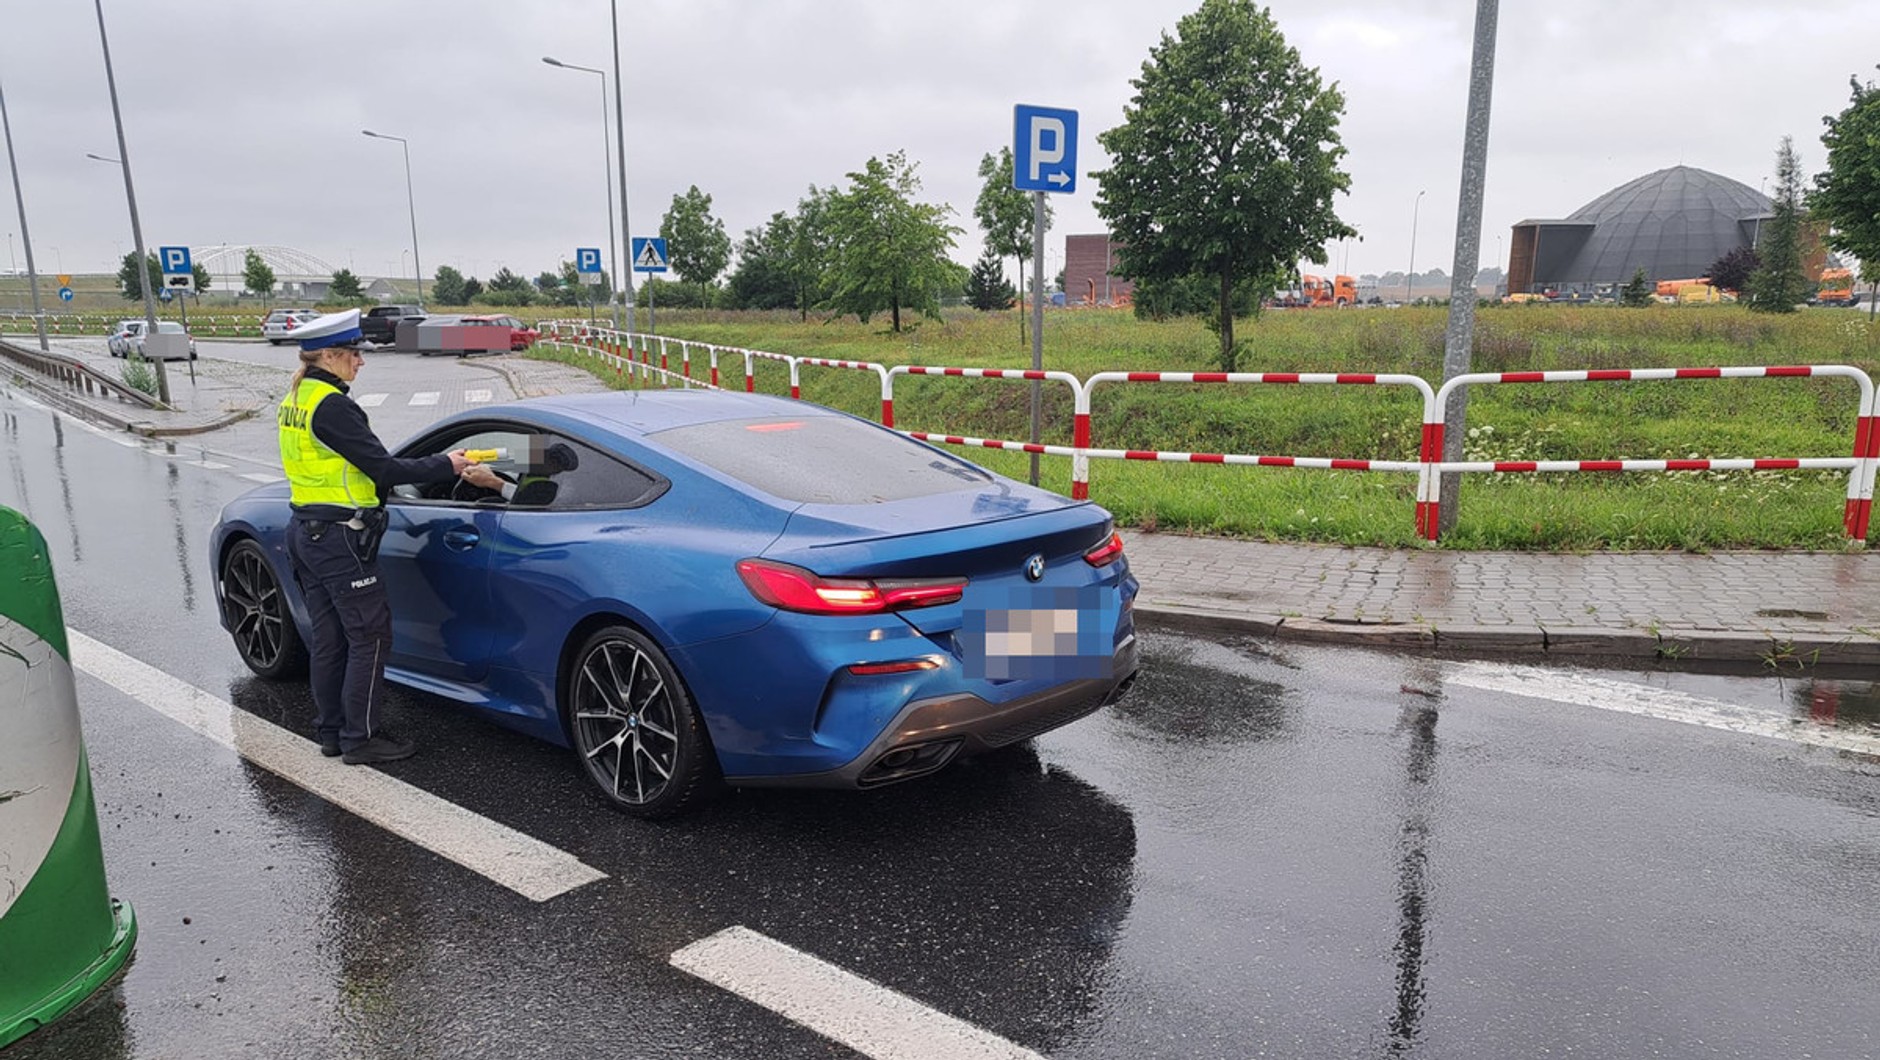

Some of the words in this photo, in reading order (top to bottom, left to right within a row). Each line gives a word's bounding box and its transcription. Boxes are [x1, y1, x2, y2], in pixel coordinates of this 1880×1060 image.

[1029, 115, 1065, 181] P
[167, 249, 185, 271] P
[582, 251, 596, 270] P
